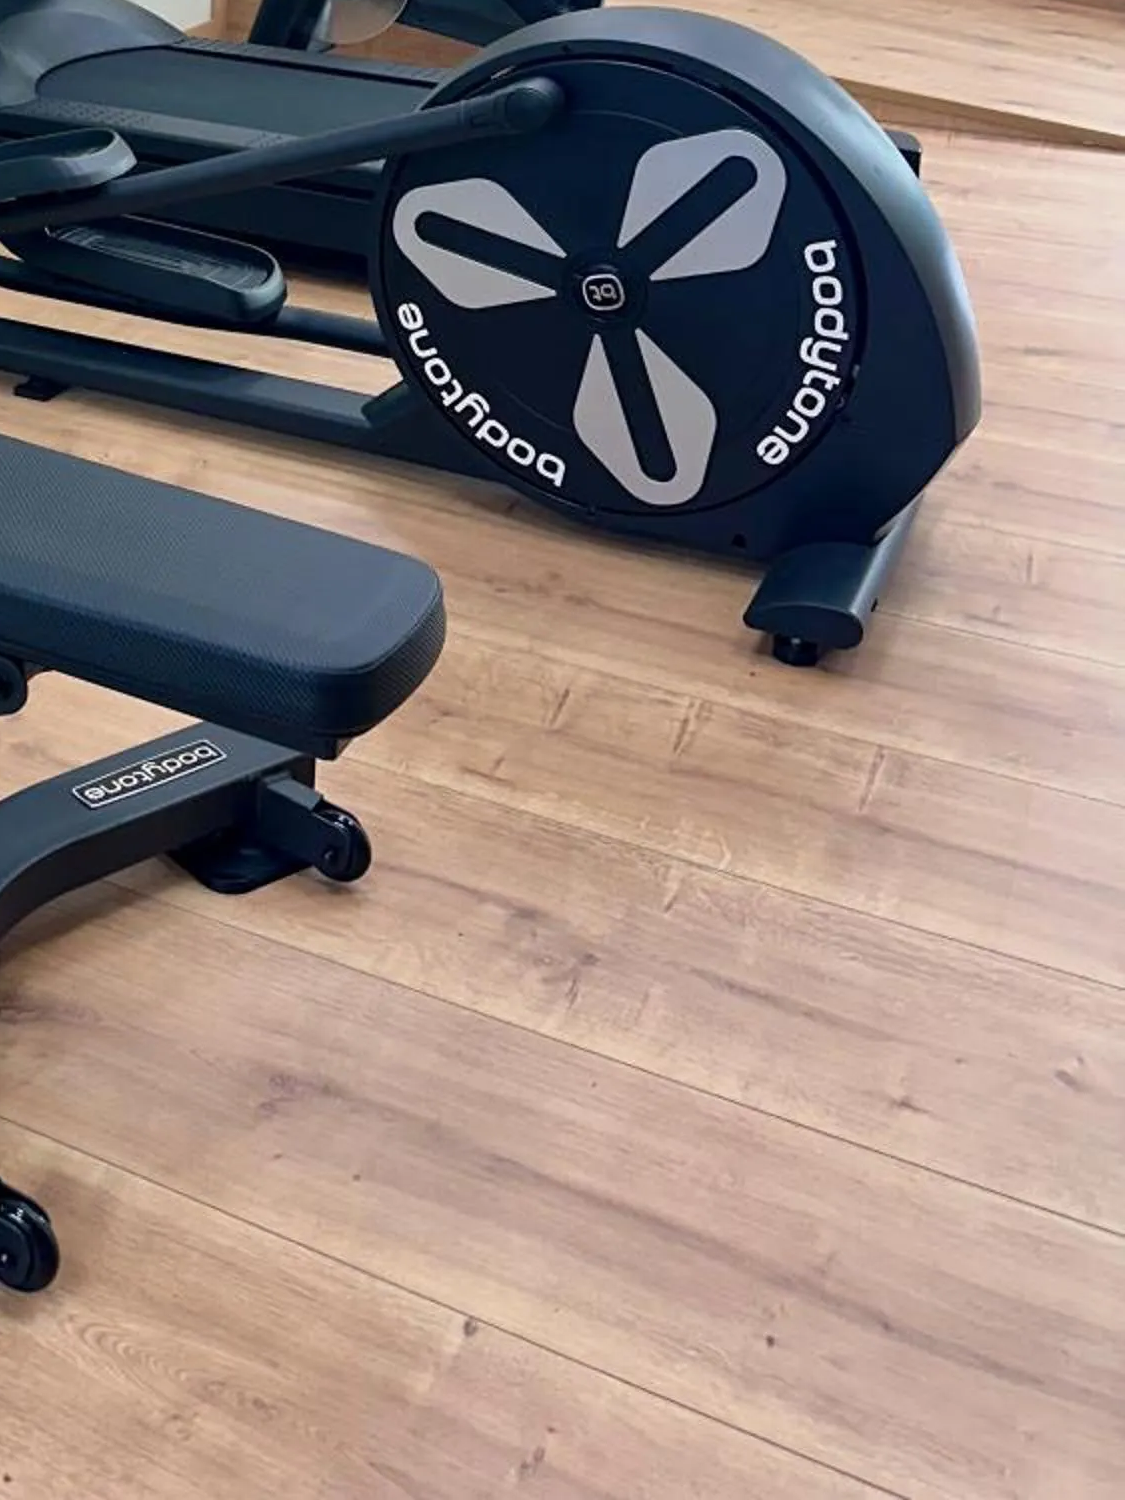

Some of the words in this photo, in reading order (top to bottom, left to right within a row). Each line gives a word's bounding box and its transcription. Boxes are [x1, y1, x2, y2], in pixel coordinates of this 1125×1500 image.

[397, 302, 567, 488] bodytone
[756, 238, 849, 467] bodytone
[83, 745, 218, 801] bodytone
